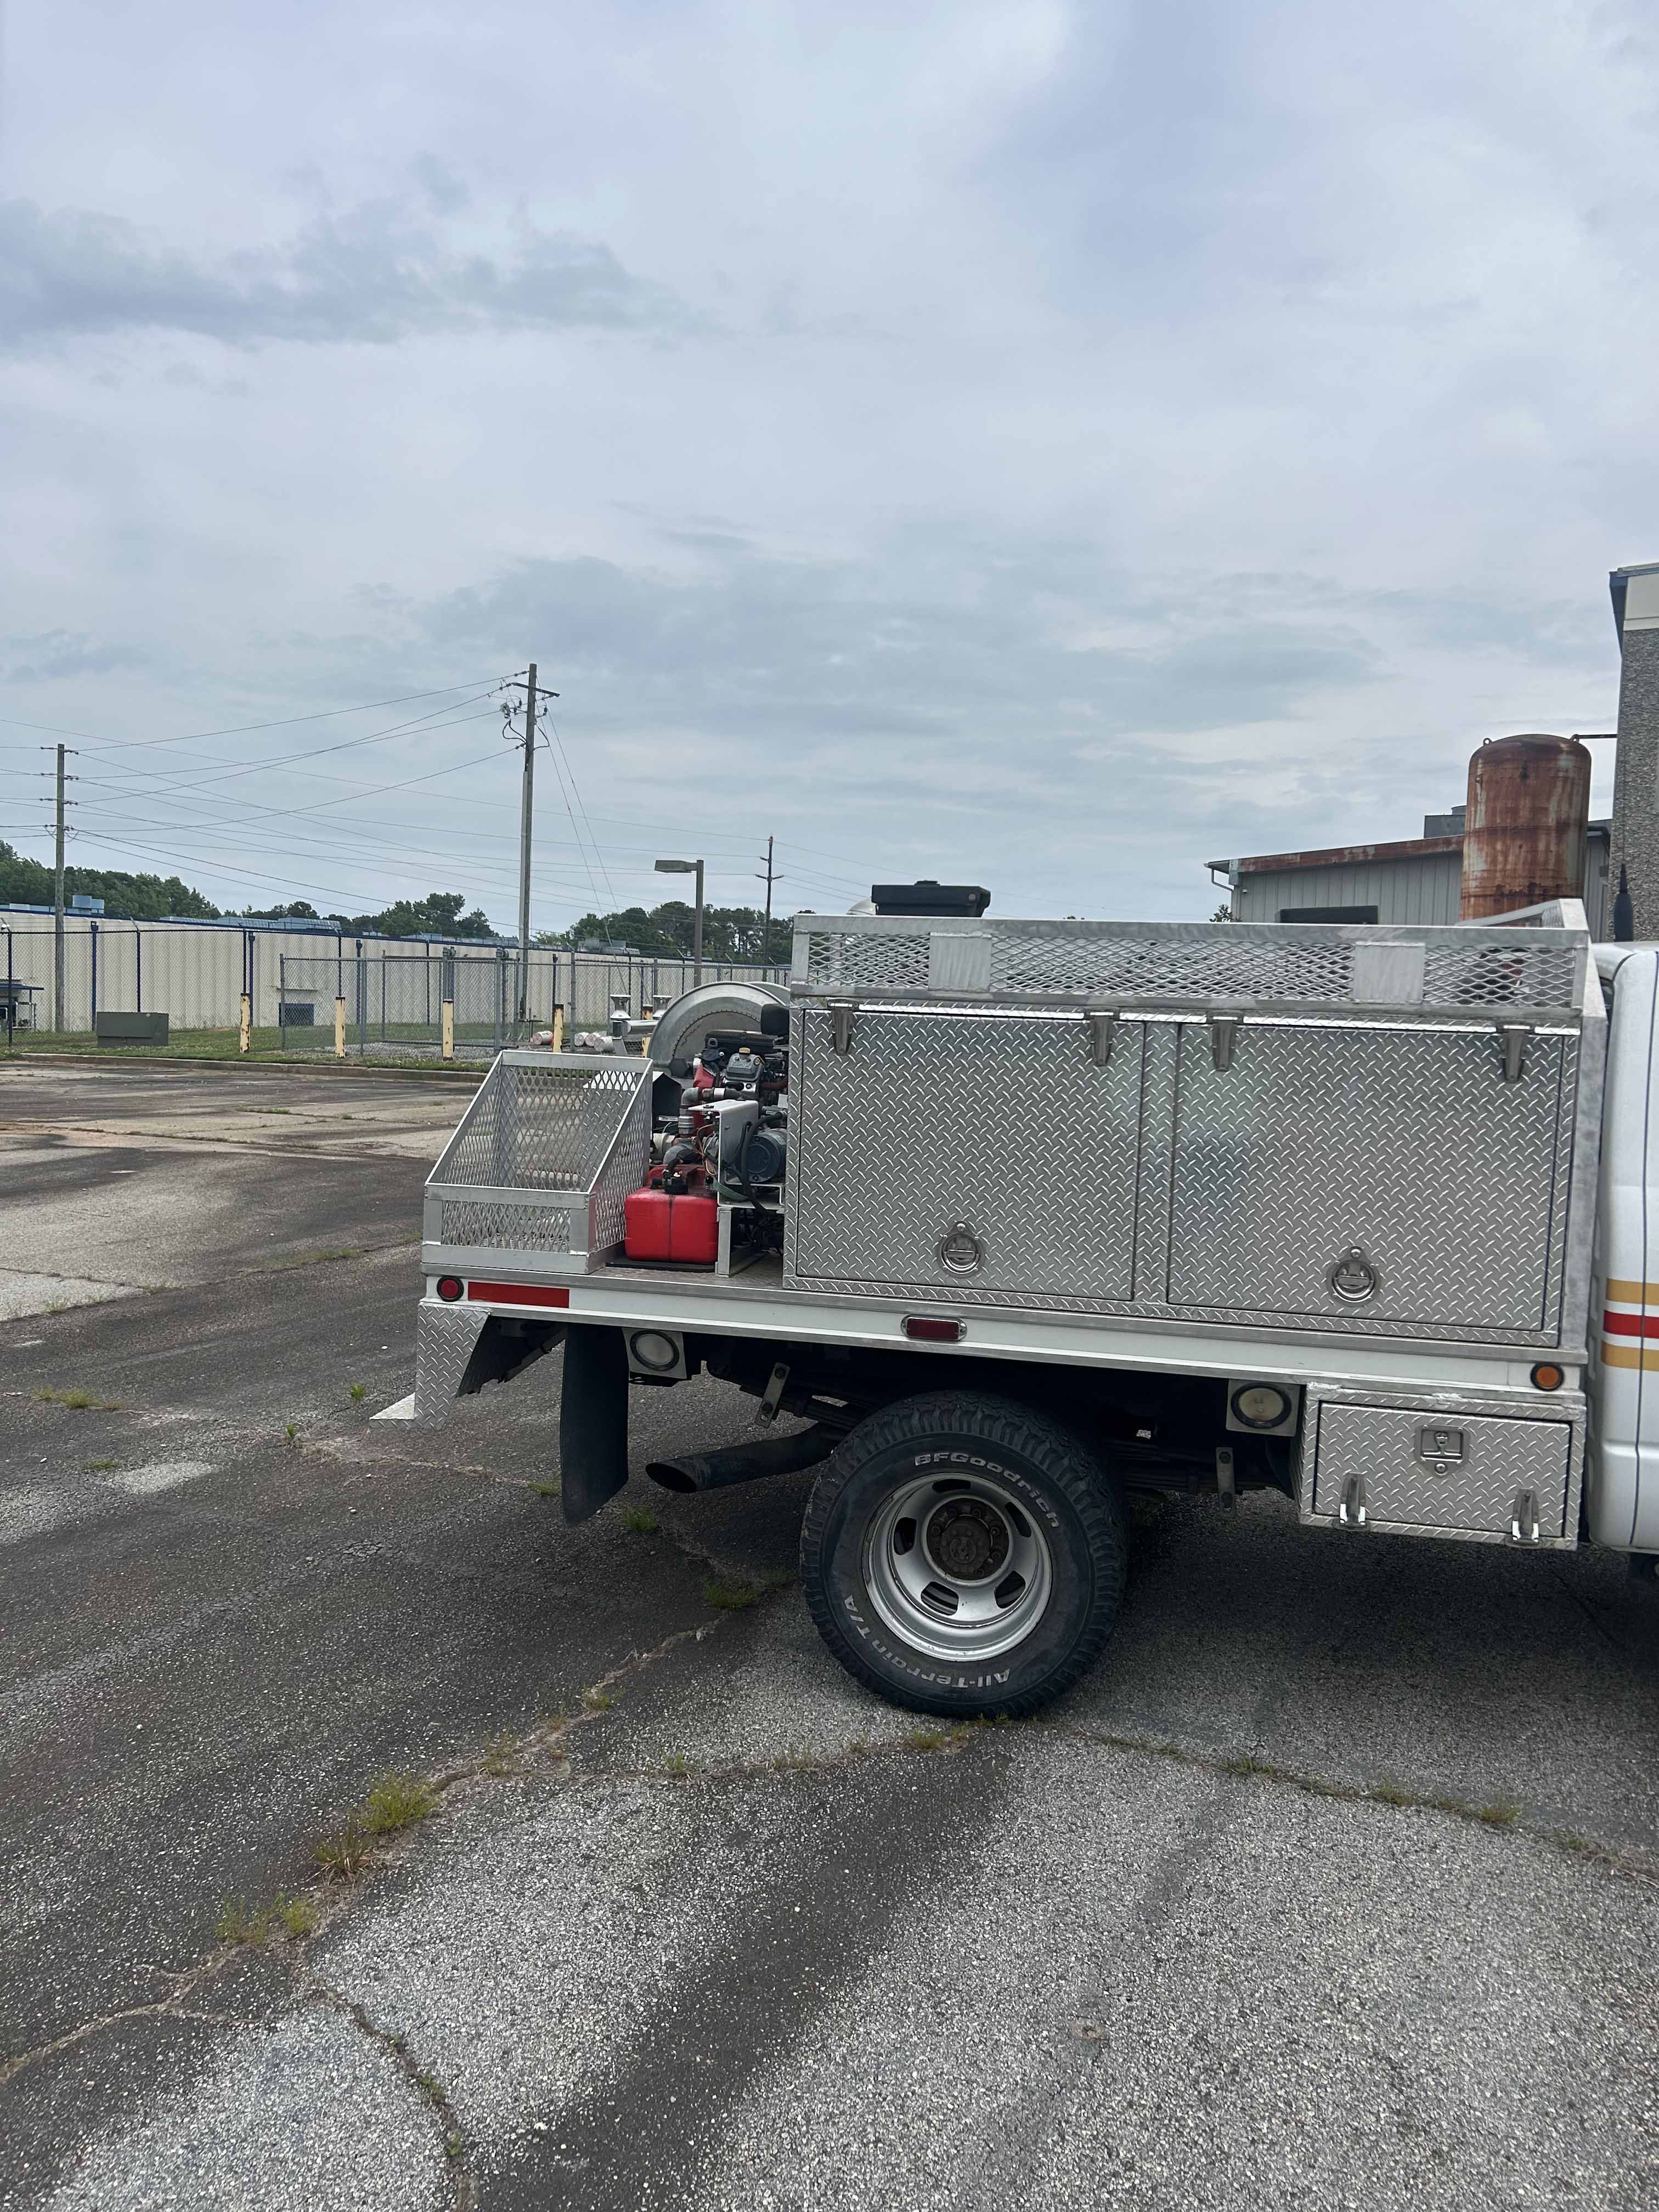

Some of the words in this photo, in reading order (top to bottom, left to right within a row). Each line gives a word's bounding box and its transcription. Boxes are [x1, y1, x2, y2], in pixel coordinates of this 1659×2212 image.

[915, 1453, 1059, 1527] BFGoodrich
[844, 1595, 871, 1639] T/A
[872, 1640, 1009, 1688] All-Terrain
